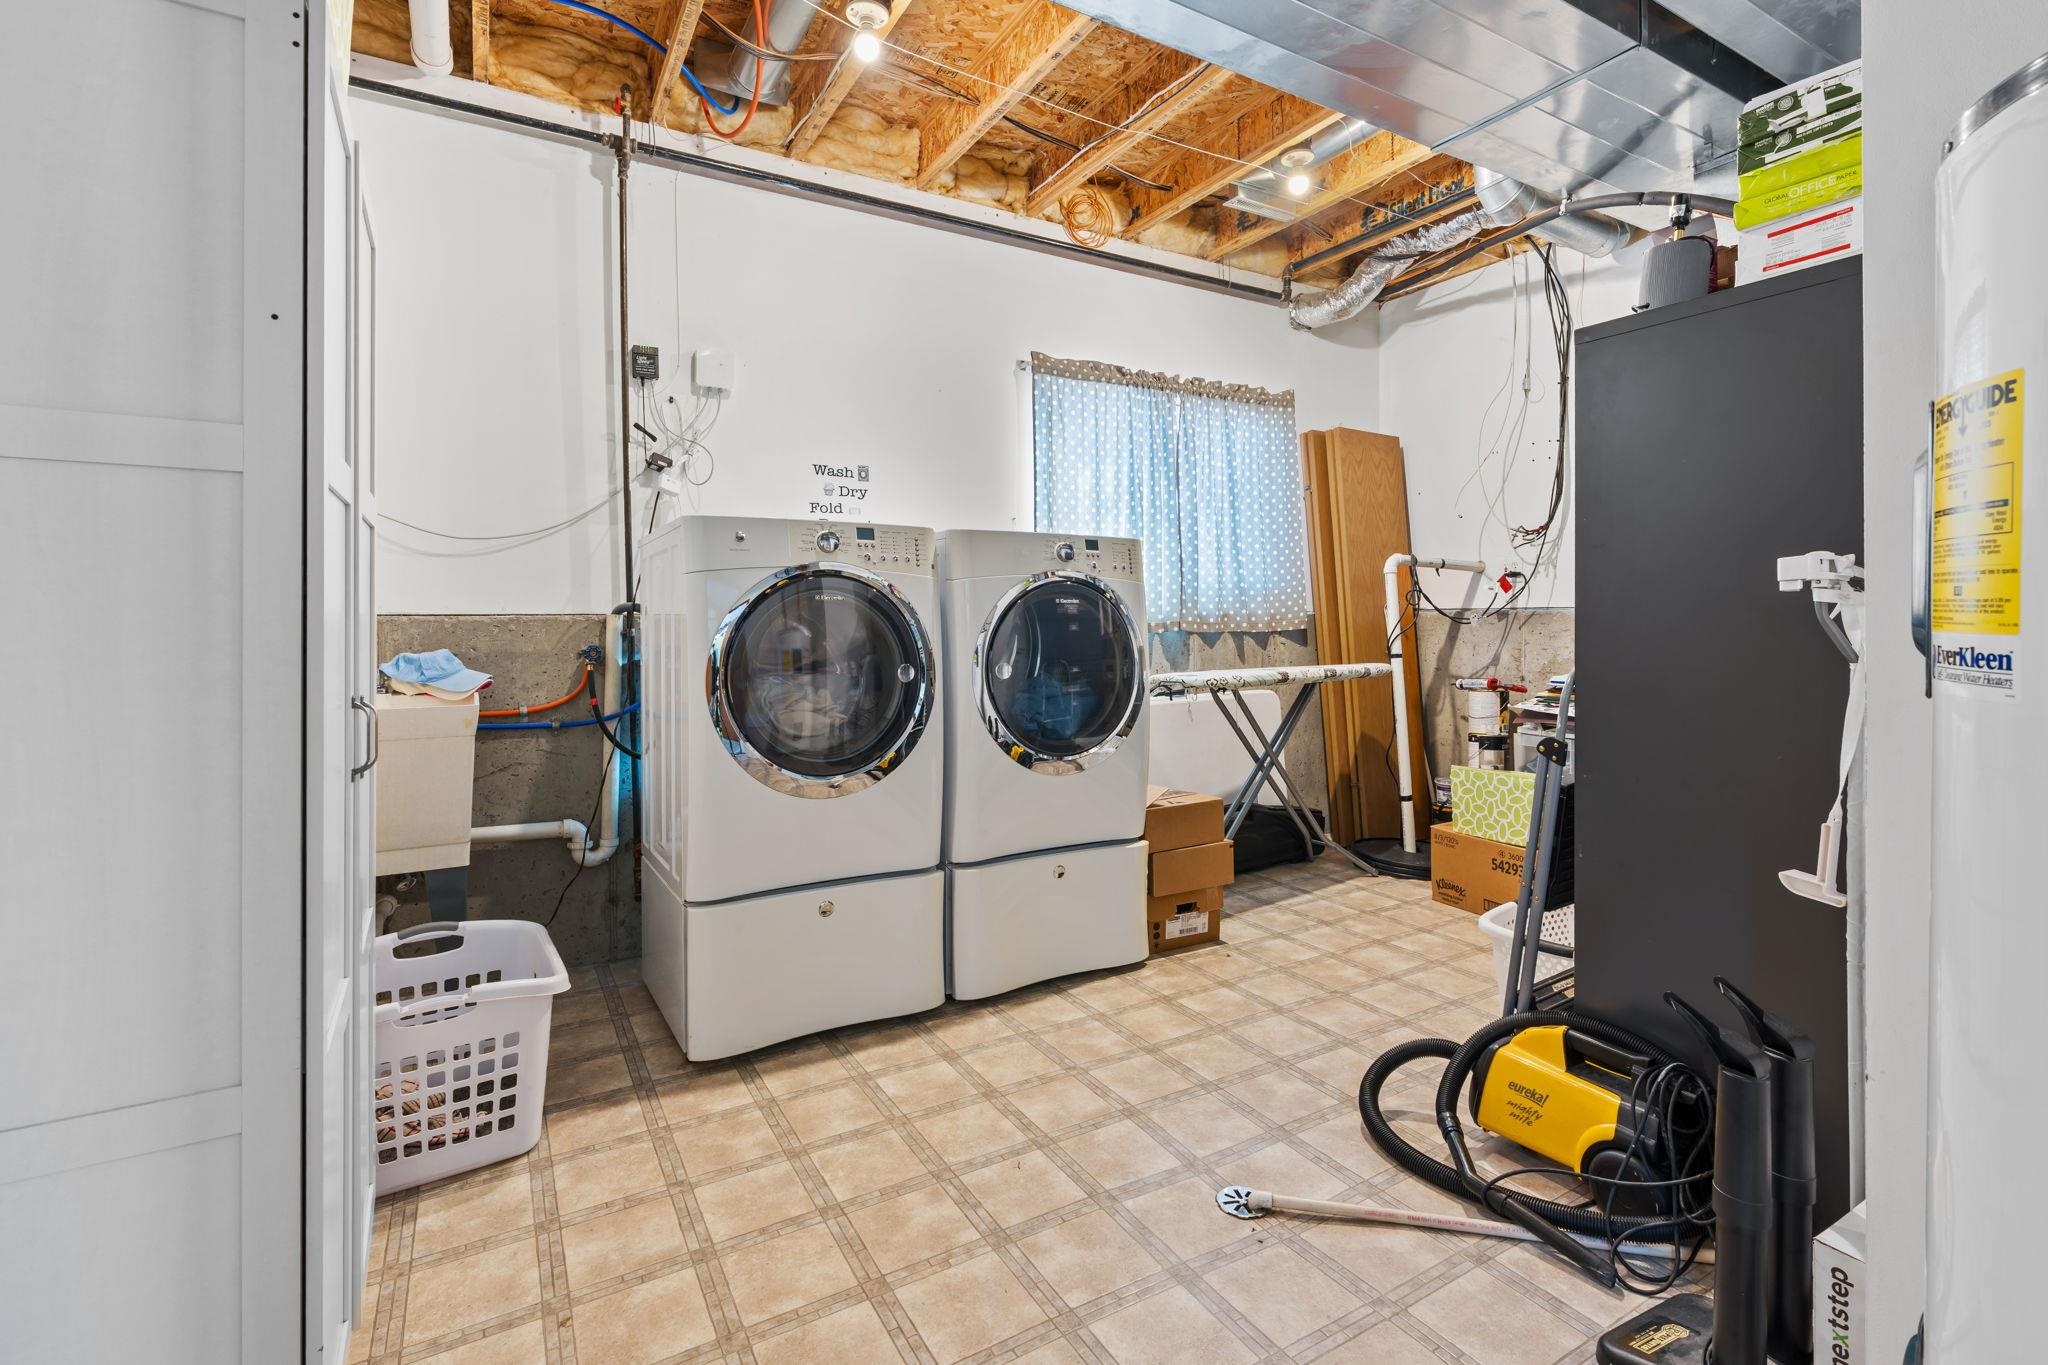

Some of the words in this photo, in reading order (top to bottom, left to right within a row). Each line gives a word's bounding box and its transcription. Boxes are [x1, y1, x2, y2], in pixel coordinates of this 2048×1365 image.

[1764, 193, 1789, 204] GLOBAL
[1788, 175, 1836, 198] OFFICE
[1836, 170, 1857, 181] PAPER
[812, 464, 854, 478] Wash
[838, 486, 868, 500] Dry
[810, 502, 844, 514] Fold
[1937, 645, 2013, 671] EverKleen
[1982, 674, 2013, 688] Heaters
[1508, 852, 1524, 862] 3600
[1436, 878, 1466, 897] Kleenex
[1508, 1081, 1550, 1108] eureka!
[1506, 1100, 1544, 1121] mighty
[1509, 1111, 1534, 1126] mite
